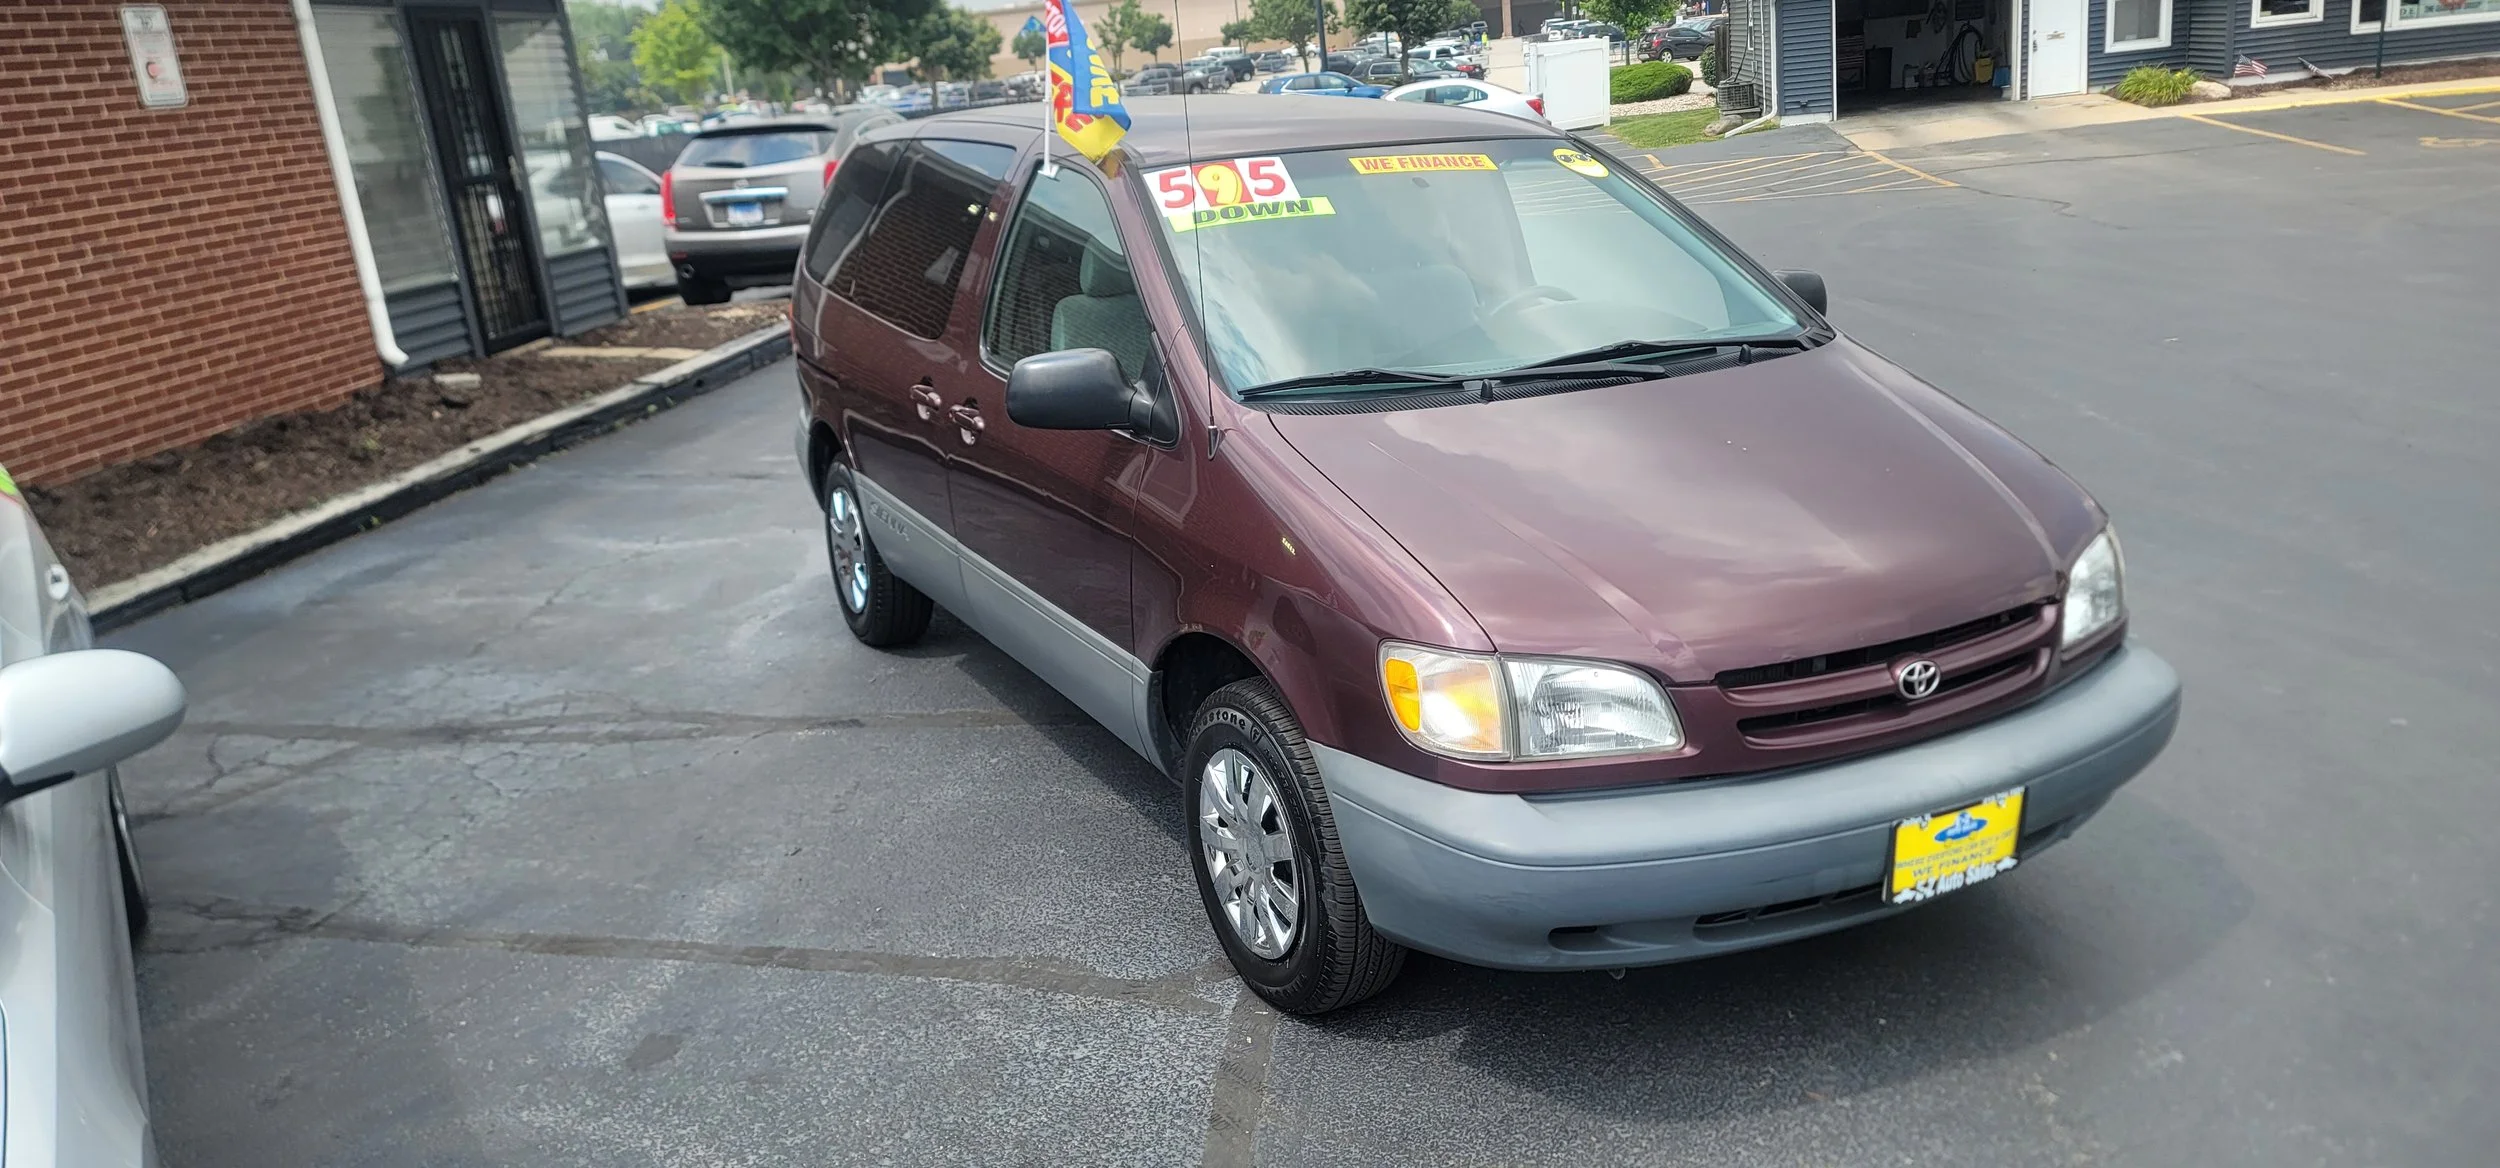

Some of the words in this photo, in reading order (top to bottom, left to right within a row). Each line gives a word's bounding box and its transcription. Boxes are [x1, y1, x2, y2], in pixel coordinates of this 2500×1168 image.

[1358, 158, 1394, 171] WE
[1397, 156, 1485, 169] FINANCE
[1159, 160, 1286, 208] 595
[1193, 200, 1312, 225] DOWN
[1193, 709, 1246, 738] estone
[1936, 872, 1964, 895] Auto
[1965, 862, 1996, 886] Sales
